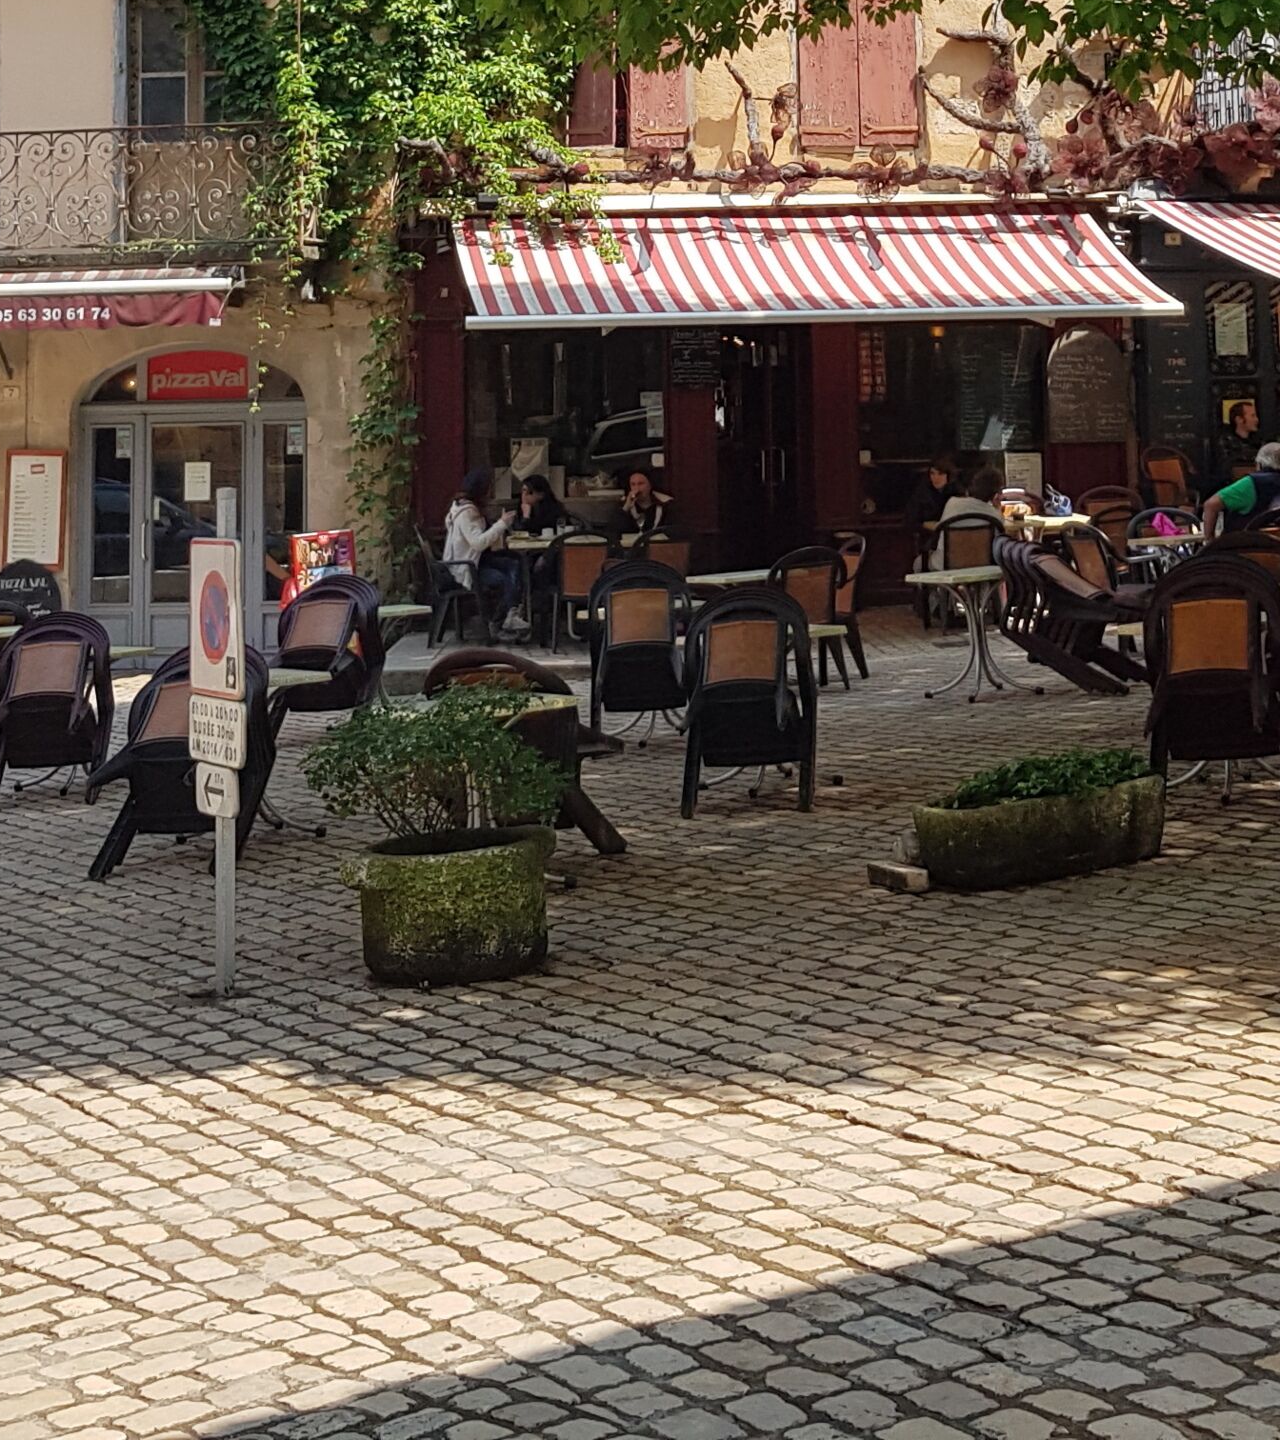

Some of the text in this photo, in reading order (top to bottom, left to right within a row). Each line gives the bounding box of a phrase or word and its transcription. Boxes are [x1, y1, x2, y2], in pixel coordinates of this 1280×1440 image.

[18, 309, 37, 320] 63
[42, 308, 62, 320] 30
[66, 308, 85, 320] 61
[91, 307, 110, 320] 74
[9, 388, 15, 398] 7
